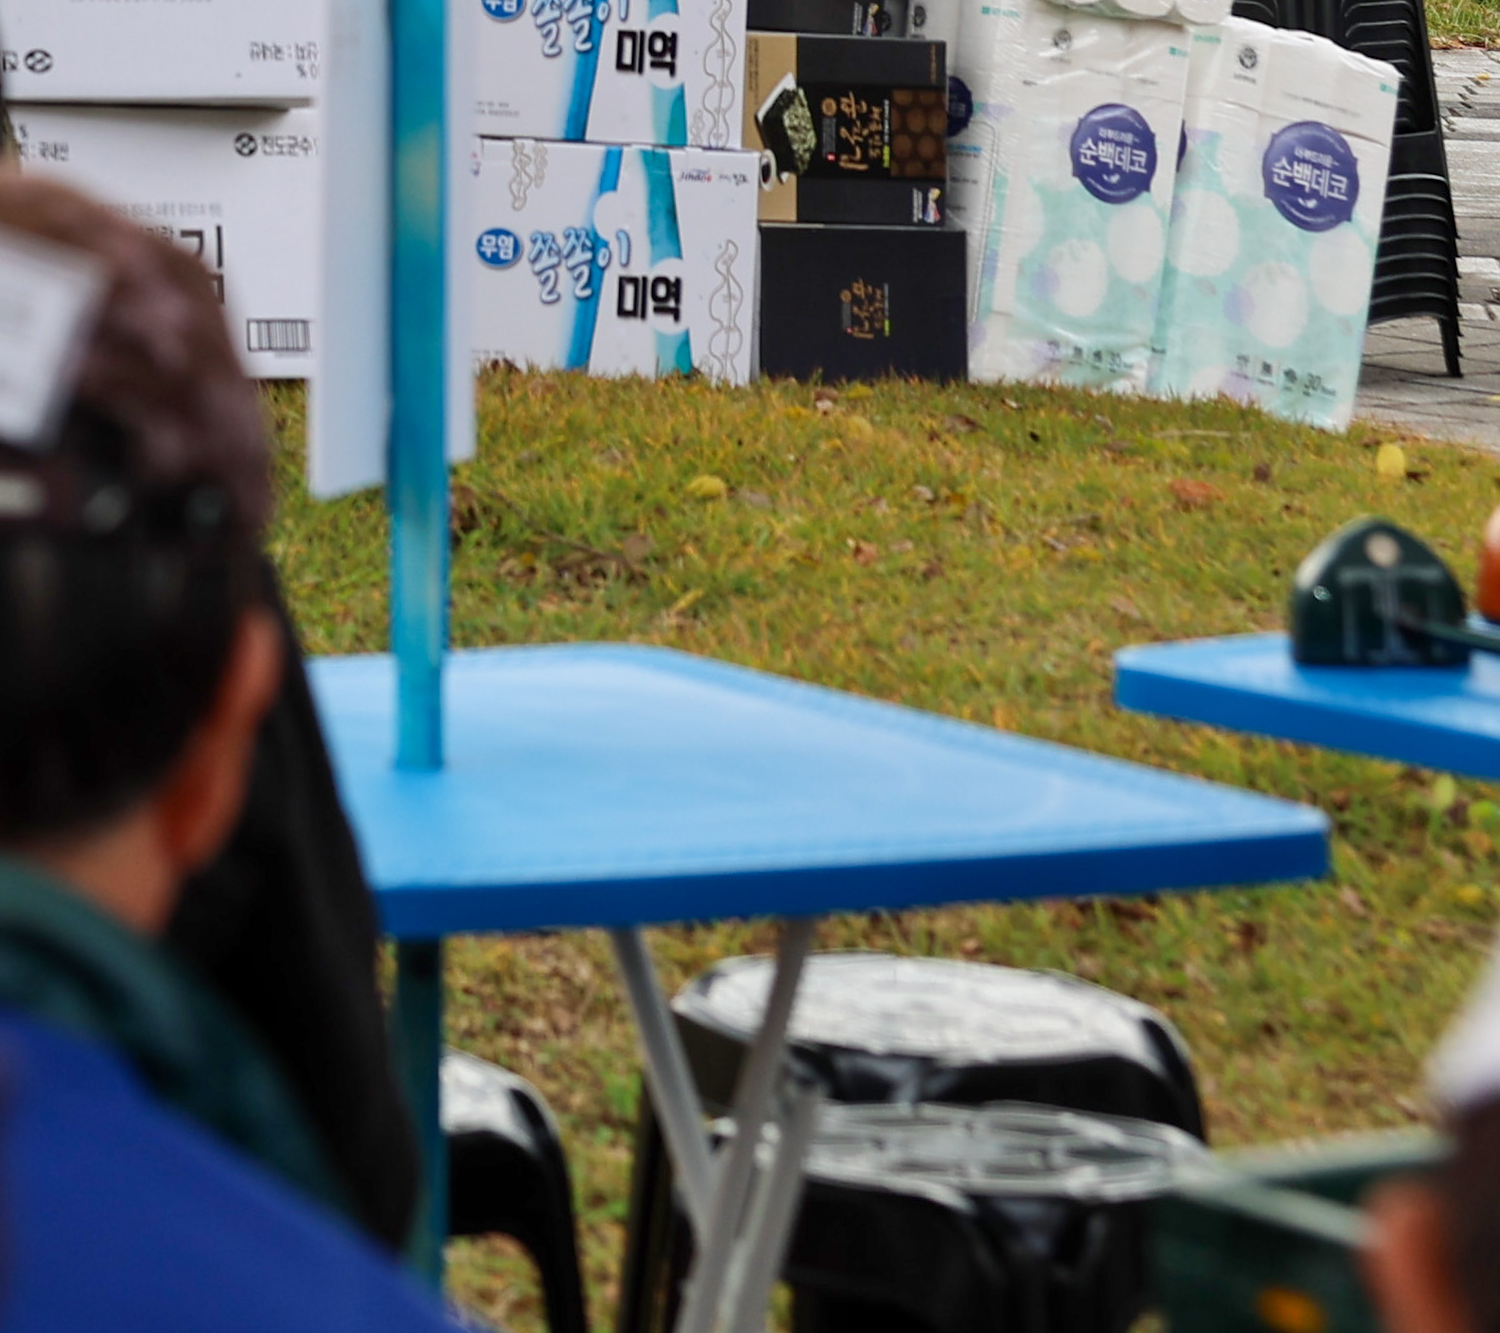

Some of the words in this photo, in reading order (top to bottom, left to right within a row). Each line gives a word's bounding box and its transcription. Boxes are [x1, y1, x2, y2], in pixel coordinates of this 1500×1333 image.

[616, 29, 678, 78] 미역
[261, 134, 319, 157] 진도군수
[1079, 137, 1148, 174] 순백데코
[1271, 156, 1349, 201] 순백데코
[480, 234, 515, 260] 무염
[617, 275, 683, 323] 미역
